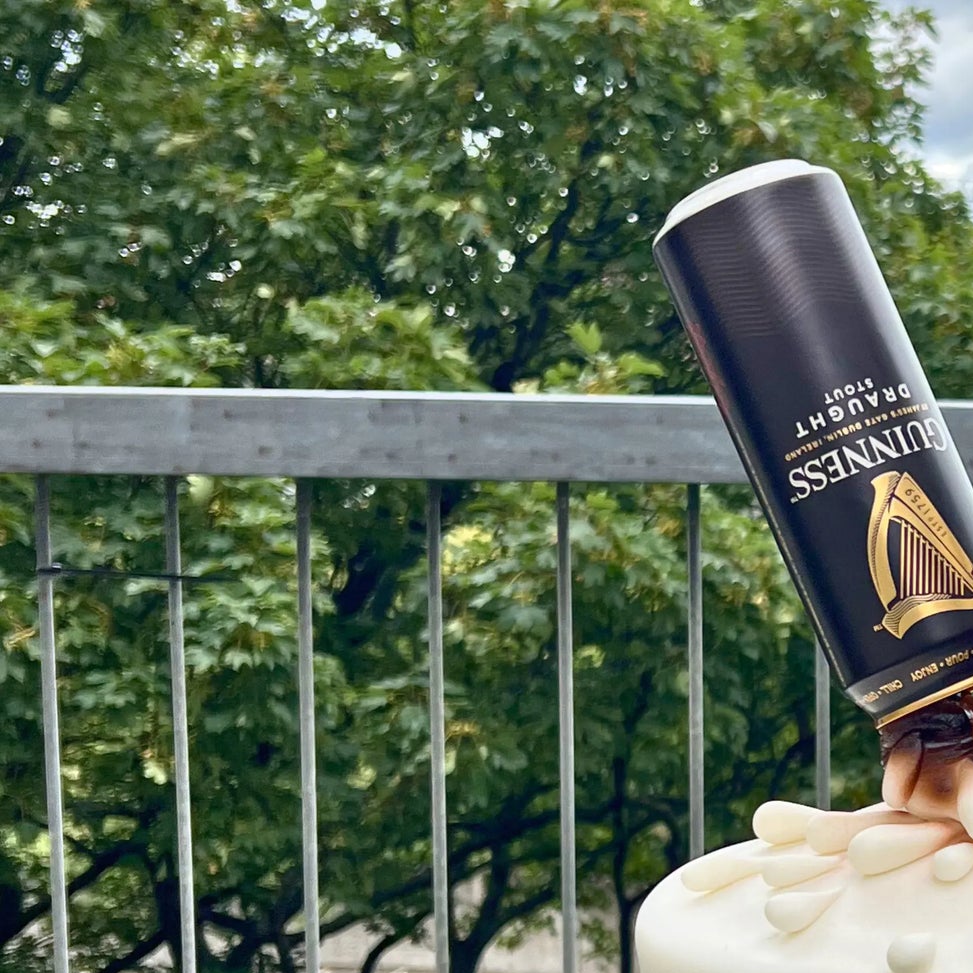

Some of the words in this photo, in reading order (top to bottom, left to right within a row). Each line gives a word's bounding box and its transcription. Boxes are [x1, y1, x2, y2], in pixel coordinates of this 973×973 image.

[824, 377, 875, 404] STOUT
[795, 383, 912, 438] DRAUGHT
[784, 442, 823, 462] IRELAND
[788, 416, 948, 500] GUINNESS
[945, 649, 969, 667] POUR
[910, 662, 939, 682] ENJOY
[882, 679, 903, 695] CHILL
